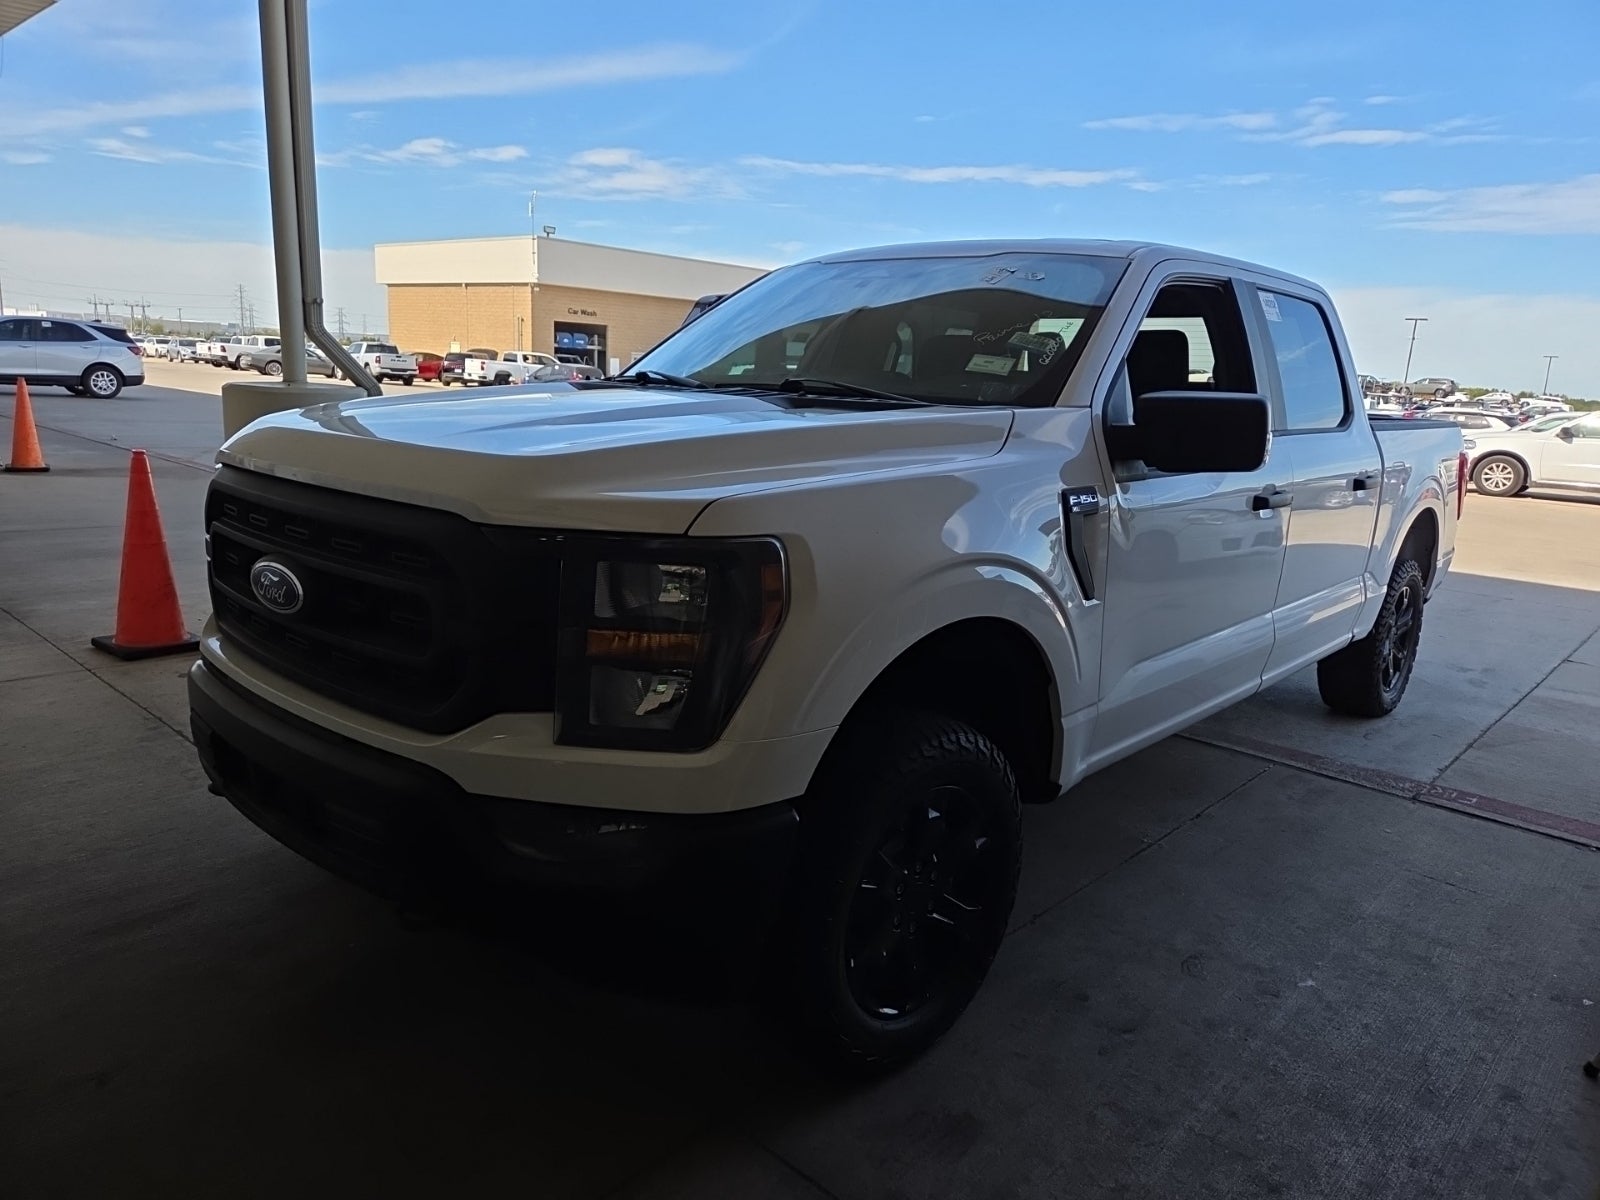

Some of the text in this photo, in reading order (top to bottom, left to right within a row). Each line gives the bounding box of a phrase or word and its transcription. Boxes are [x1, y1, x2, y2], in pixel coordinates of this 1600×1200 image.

[568, 307, 597, 317] Car Wash
[1070, 495, 1098, 505] F-150
[258, 571, 287, 603] Ford
